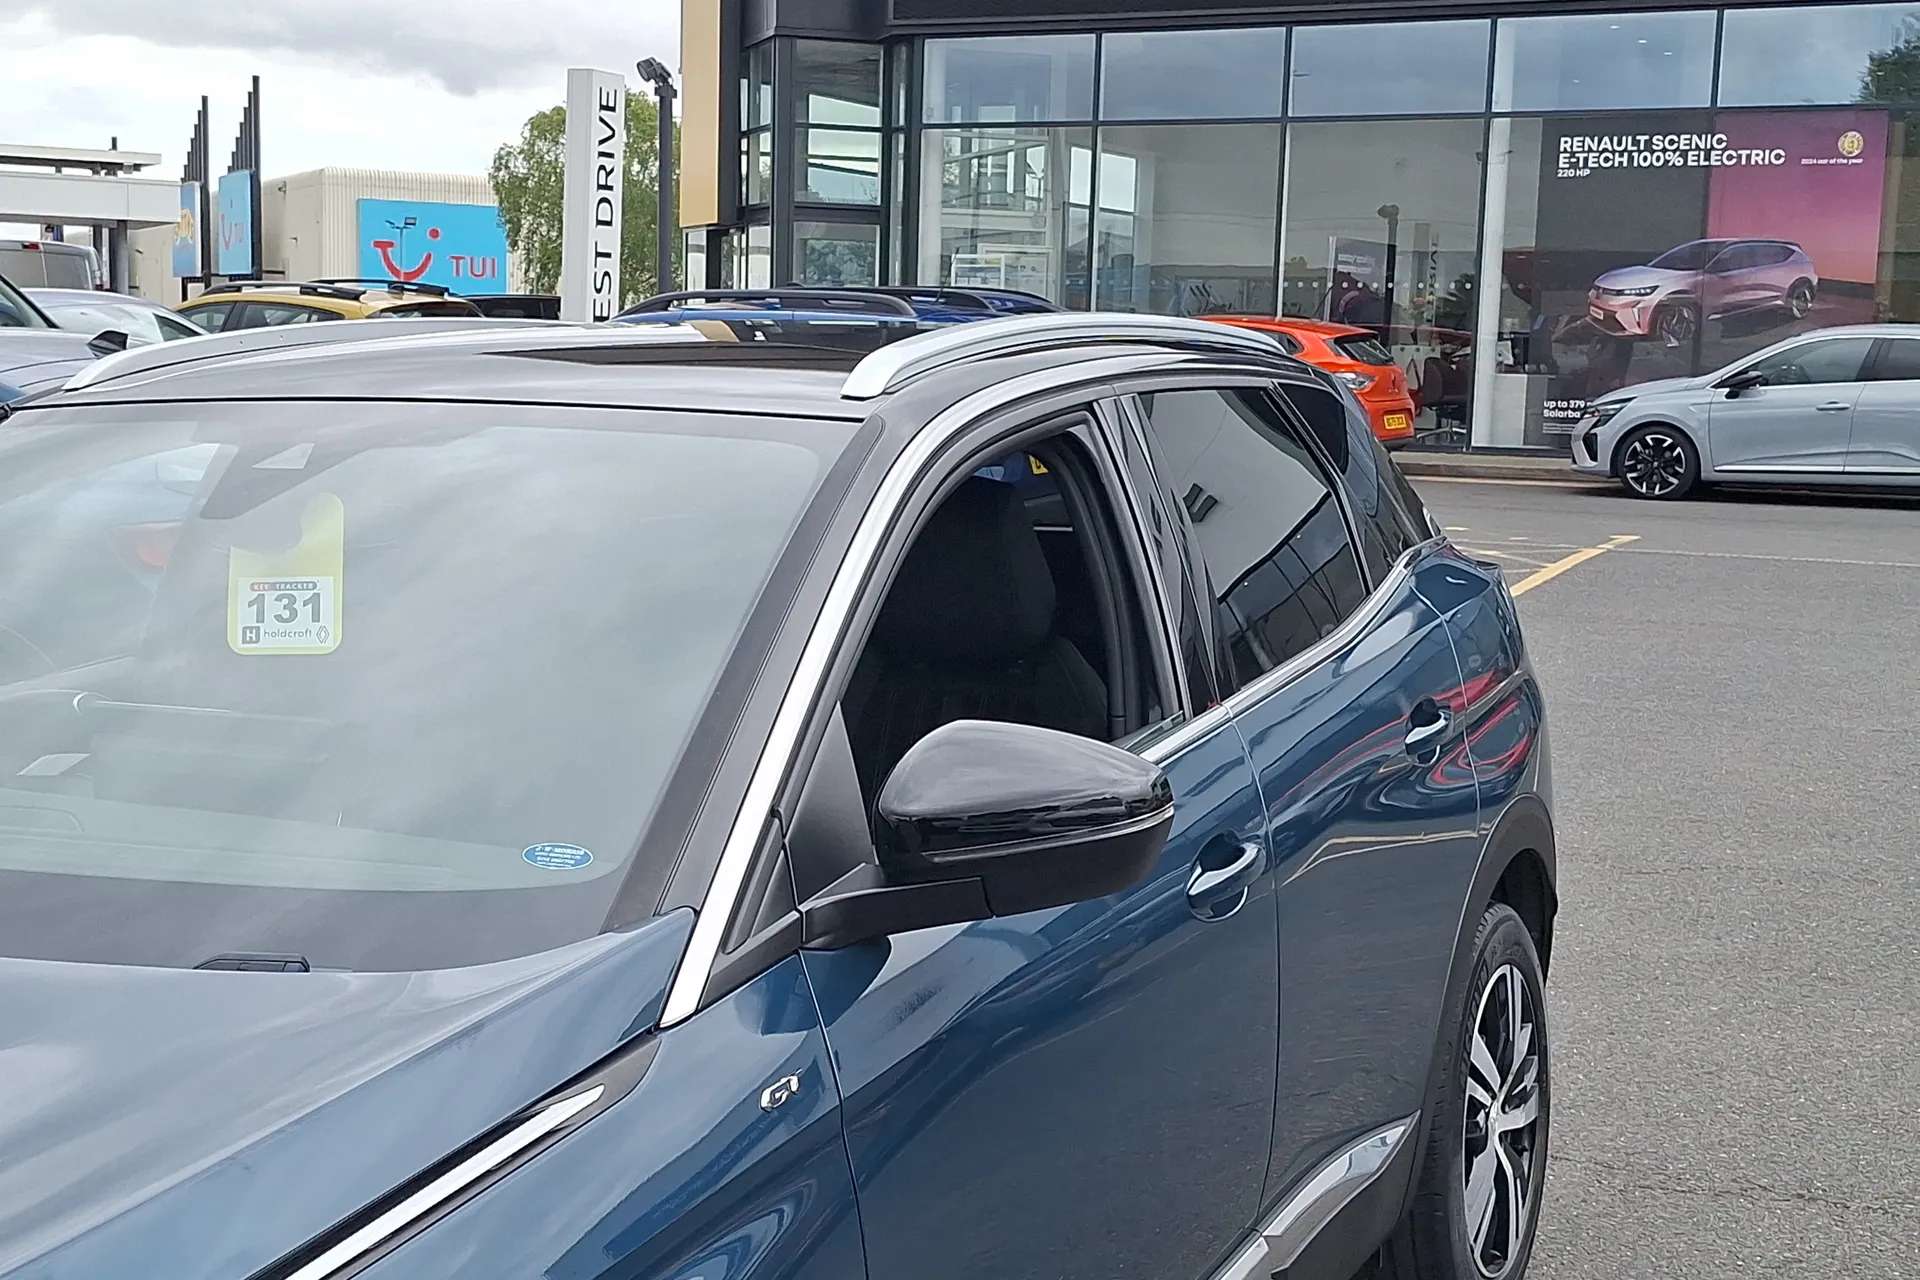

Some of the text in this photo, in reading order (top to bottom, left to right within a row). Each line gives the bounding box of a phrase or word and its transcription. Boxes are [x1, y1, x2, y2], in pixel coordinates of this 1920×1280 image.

[1559, 133, 1728, 153] RENAULT SCENIC
[1558, 149, 1786, 168] E-TECH 100% ELECTRIC
[1557, 168, 1590, 177] 220 HP
[593, 86, 617, 323] EST DRIVE
[449, 255, 497, 278] TUI
[1543, 400, 1557, 409] up
[1557, 400, 1568, 408] to
[1543, 409, 1581, 418] Solarba
[253, 582, 314, 591] KEY TRACKER
[248, 592, 320, 623] 131
[244, 627, 312, 642] H holdcroft
[760, 1075, 799, 1111] GT
